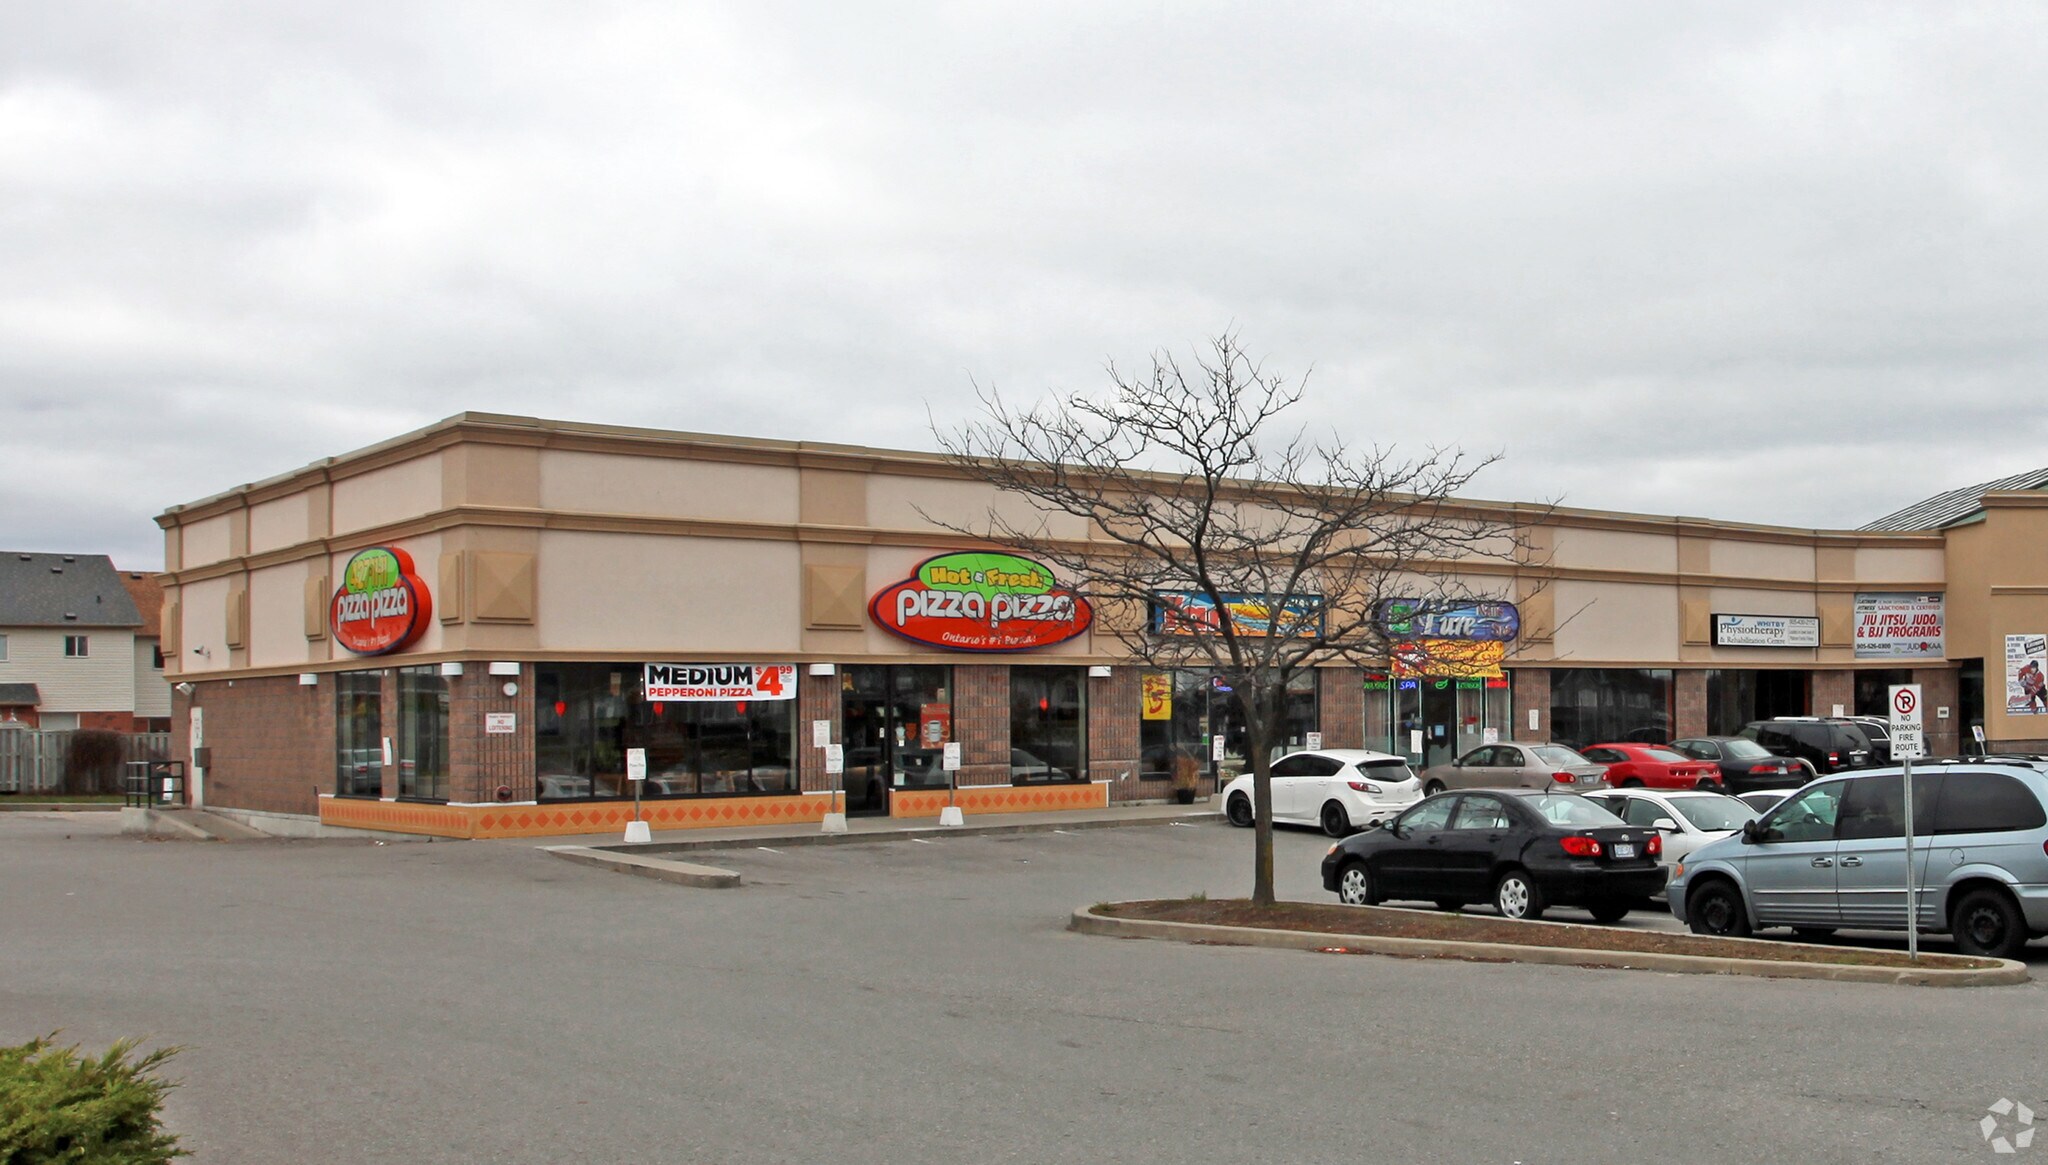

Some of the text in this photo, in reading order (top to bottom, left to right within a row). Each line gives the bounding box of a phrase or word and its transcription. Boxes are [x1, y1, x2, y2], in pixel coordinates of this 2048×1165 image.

[930, 566, 971, 585] Hot
[973, 571, 984, 583] &
[337, 587, 408, 633] pizza pizza
[896, 589, 985, 627] pizza
[1756, 620, 1785, 628] WHITBY
[1862, 614, 1878, 626] JIU
[1911, 614, 1938, 626] JUDO
[1719, 623, 1786, 638] Physiotherapy
[1856, 626, 1942, 638] & BJJ PROGRAMS
[942, 632, 987, 645] Ontario's
[649, 665, 753, 685] MEDIUM
[1400, 680, 1417, 690] SPA
[649, 688, 753, 697] PEPPERONI PIZZA
[1898, 733, 1914, 741] FIRE
[1895, 743, 1918, 751] ROUTE
